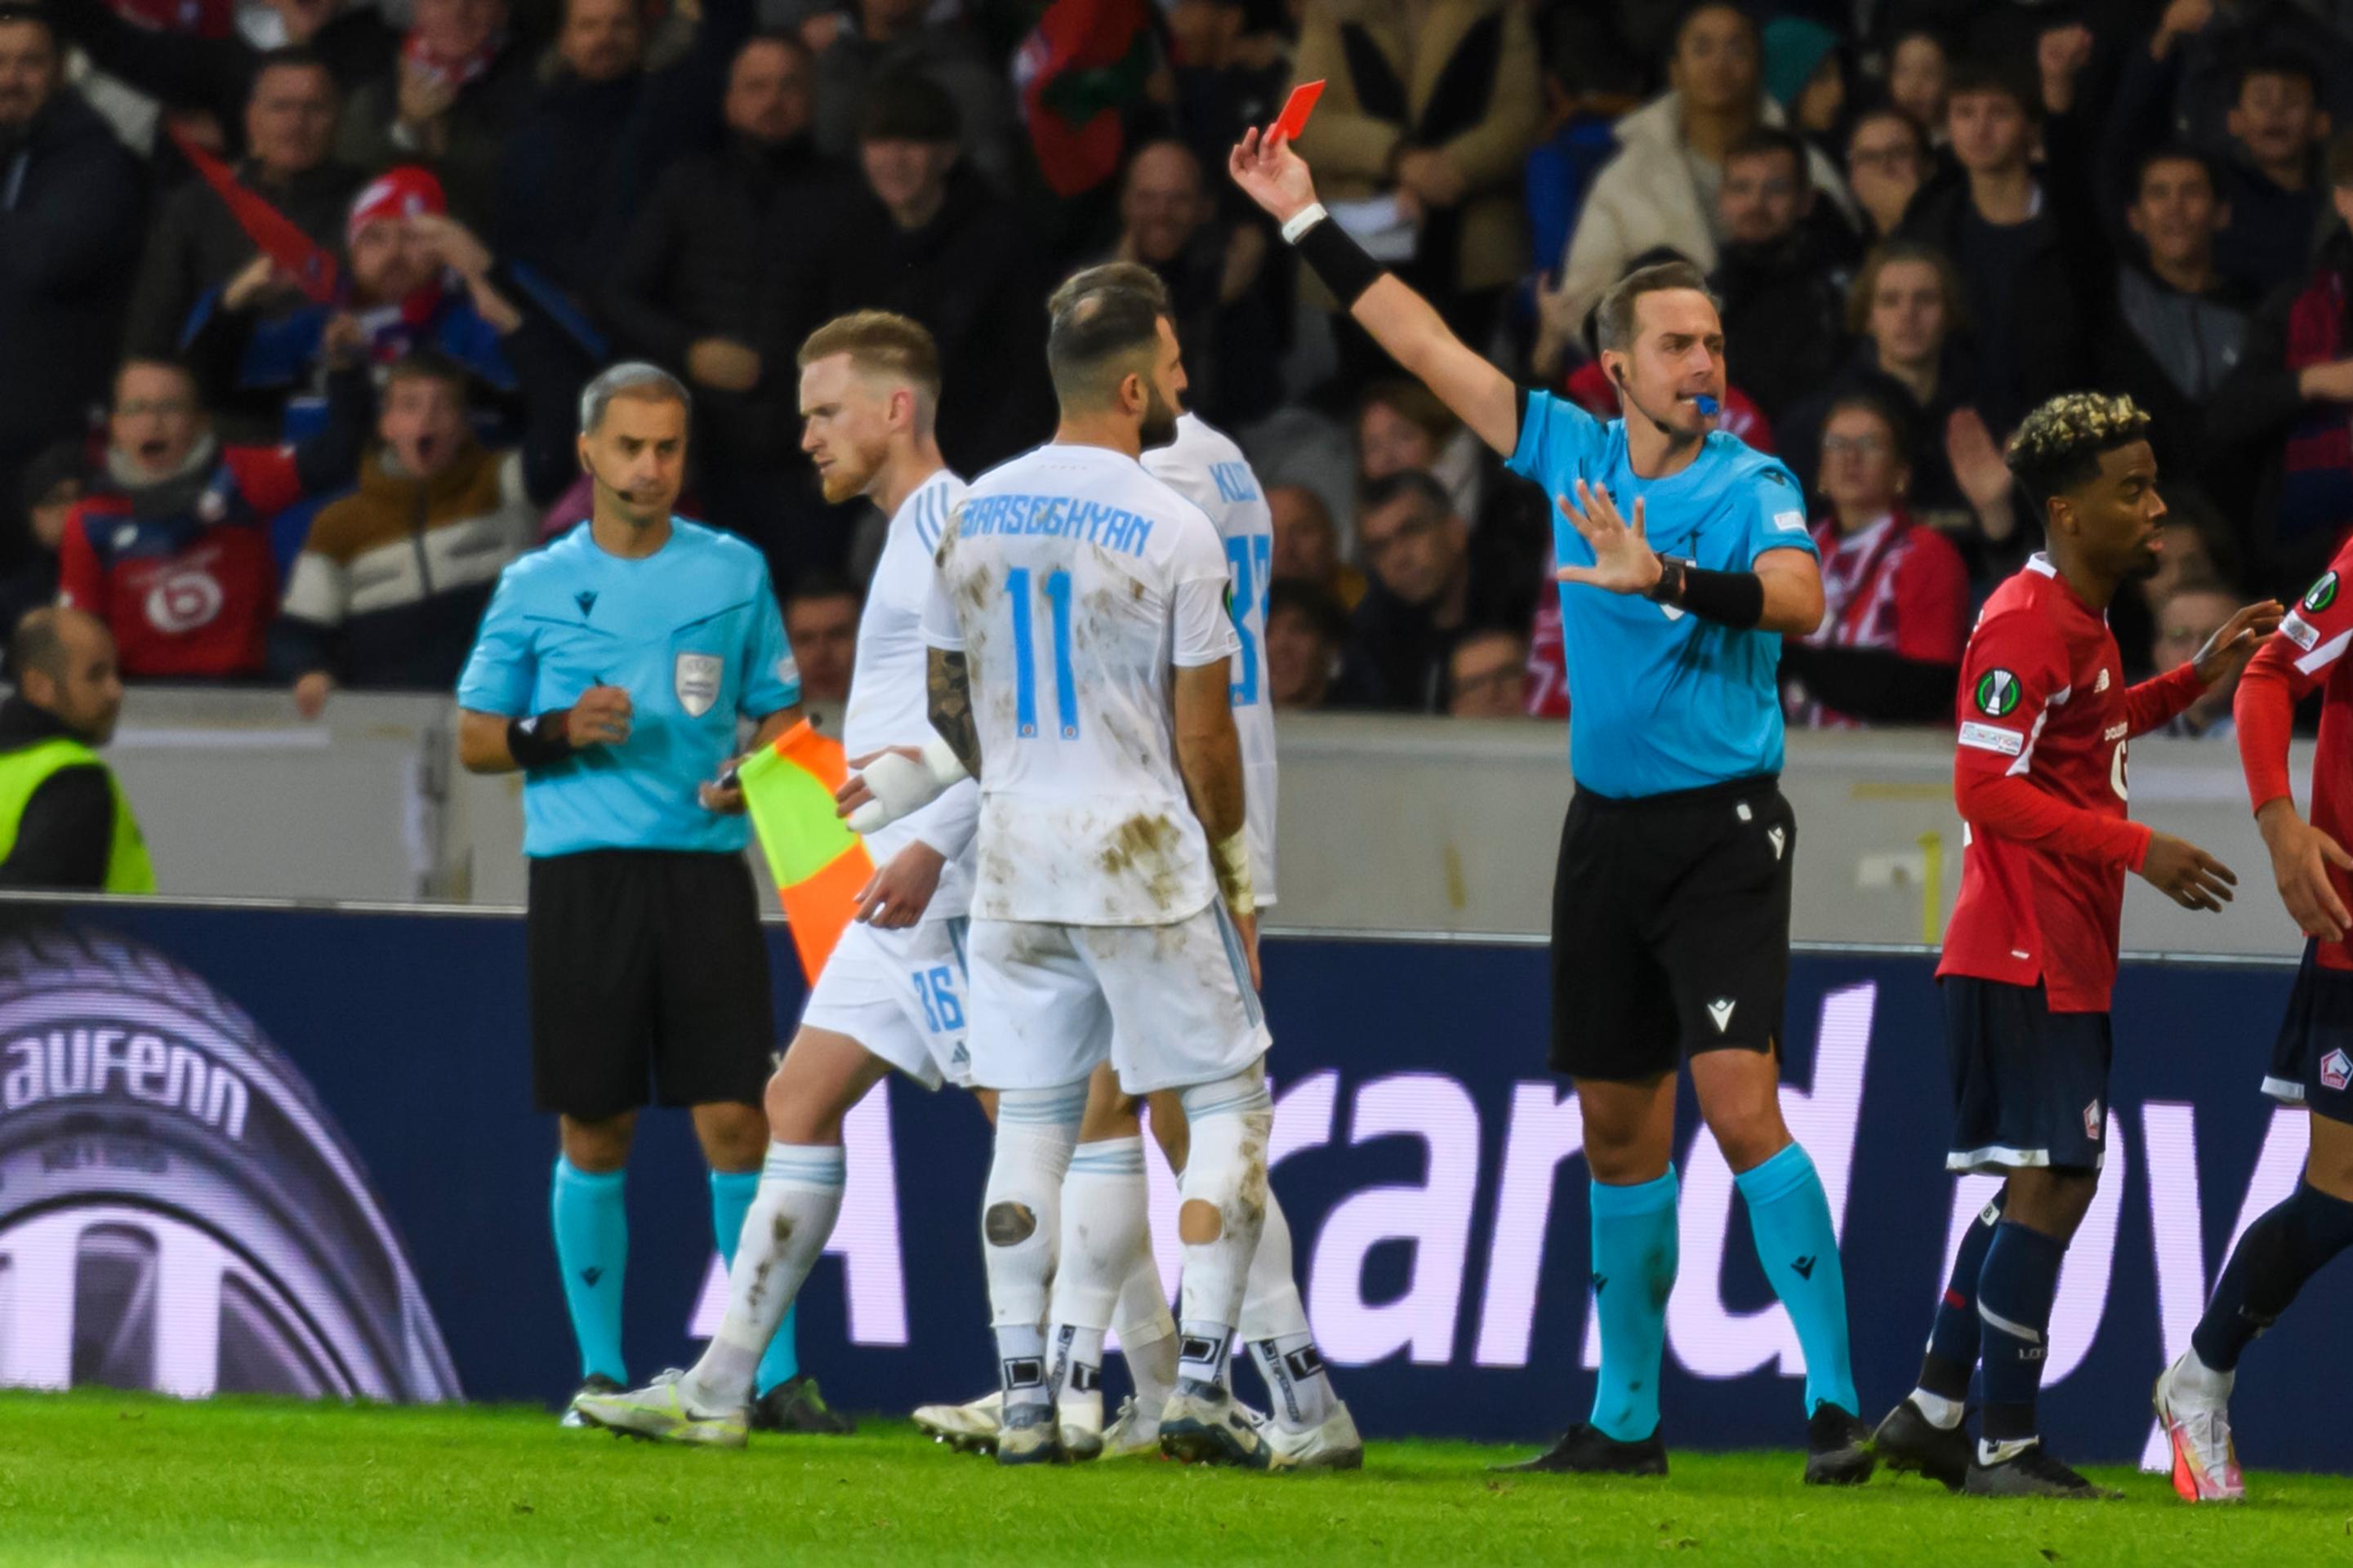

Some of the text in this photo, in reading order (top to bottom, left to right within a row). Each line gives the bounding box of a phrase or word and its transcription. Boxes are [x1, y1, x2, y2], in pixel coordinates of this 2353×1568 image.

[960, 494, 1154, 558] BARSEGHYAN
[1004, 567, 1080, 739] 11
[1101, 980, 1878, 1379] rand
